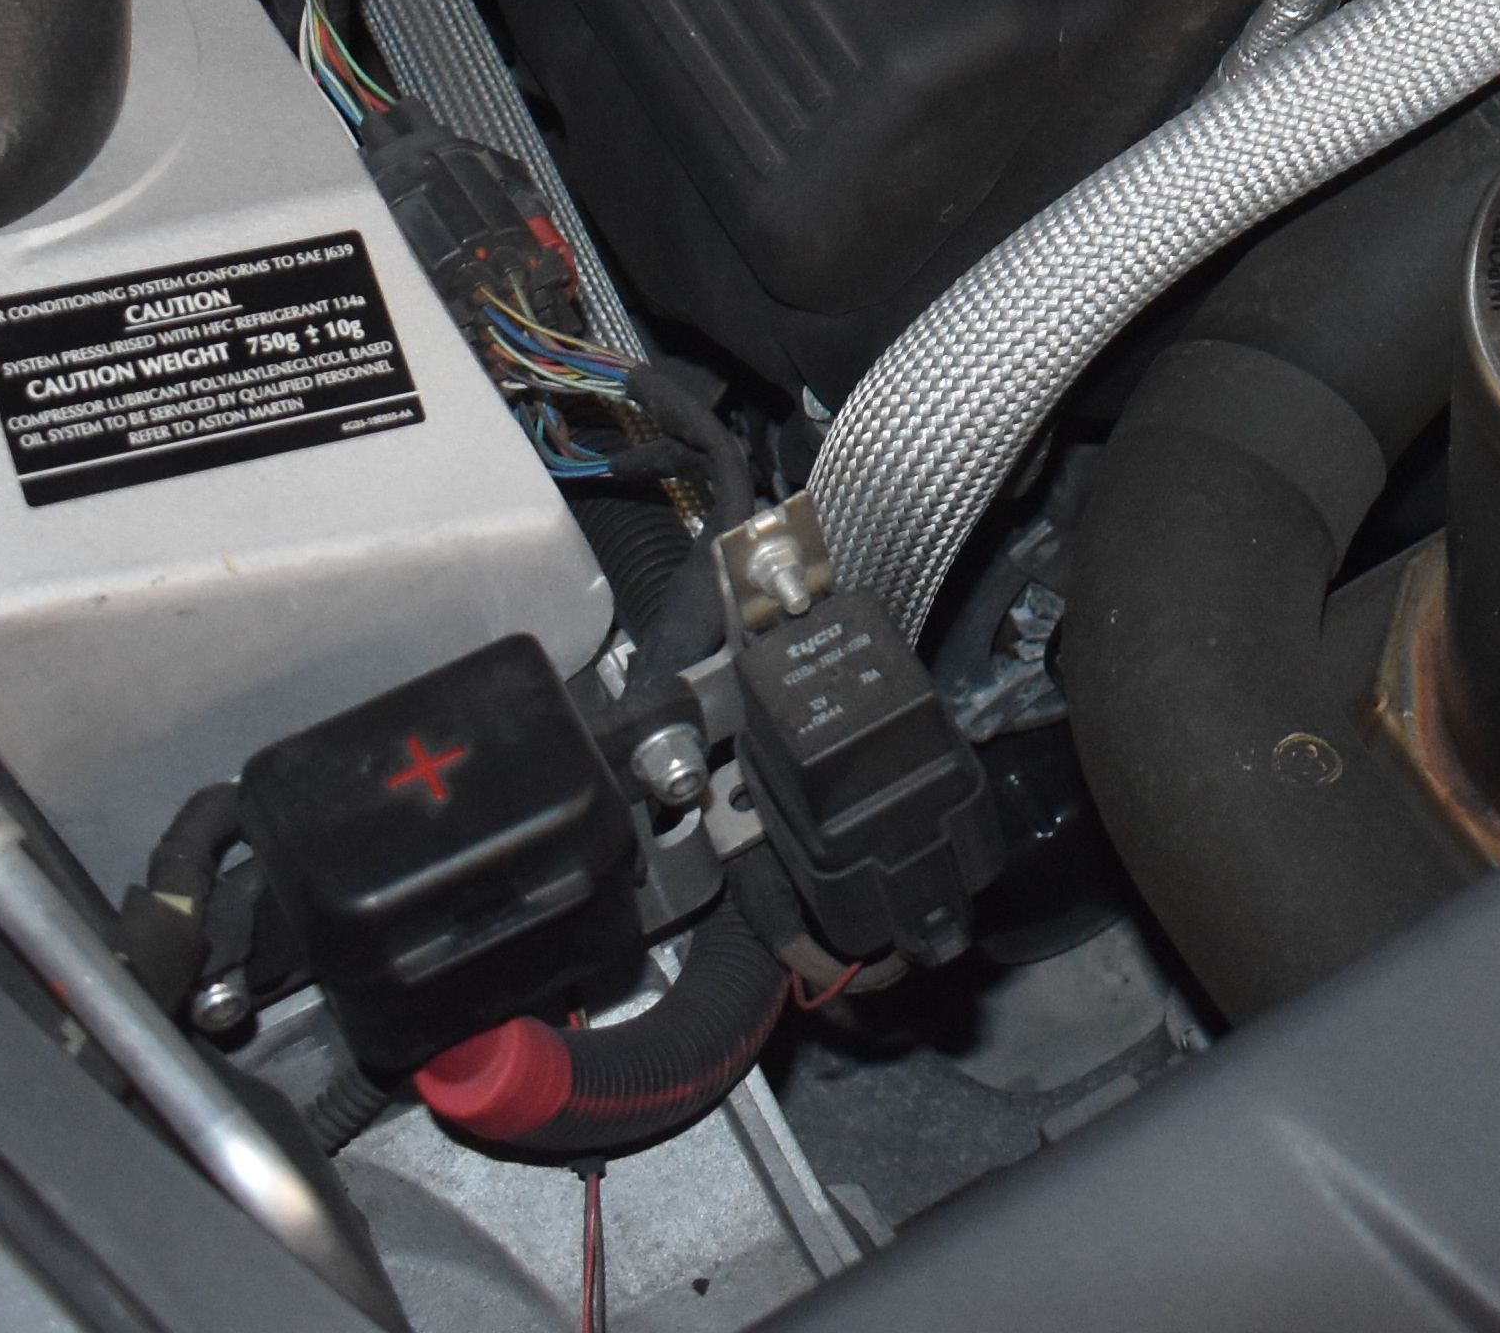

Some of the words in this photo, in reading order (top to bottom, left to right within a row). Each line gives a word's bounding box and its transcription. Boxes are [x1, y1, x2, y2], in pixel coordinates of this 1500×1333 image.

[8, 287, 126, 320] CONDITIONING
[129, 276, 184, 298] SYSTEM
[185, 259, 271, 287] CONFORMS
[273, 255, 294, 270] TO
[297, 249, 322, 265] SAE
[325, 243, 354, 262] J639
[124, 287, 232, 324] CAUTION
[2, 353, 59, 377] SYSTEM
[61, 335, 156, 365] PRESSURISED
[157, 325, 201, 344] WITH
[202, 318, 233, 336] HFC
[235, 300, 330, 329] REFRIGERANT
[333, 294, 366, 310] 134a
[25, 361, 136, 399] CAUTION
[138, 342, 230, 376] WEIGHT
[246, 331, 300, 355] 750g
[324, 318, 365, 340] 10g
[7, 400, 107, 431] COMPRESSOR
[106, 382, 188, 410] LUBRICANT
[350, 340, 393, 361] BASED
[20, 432, 46, 448] OIL
[47, 419, 104, 442] SYSTEM
[103, 415, 127, 429] TO
[127, 410, 148, 425] BE
[149, 396, 216, 423] SERVICED
[218, 391, 236, 407] BY
[238, 376, 313, 403] QUALIFIED
[315, 359, 394, 386] PERSONNEL
[128, 426, 170, 446] REFER
[172, 420, 196, 434] TO
[198, 407, 247, 432] ASTON
[249, 396, 305, 419] MARTIN
